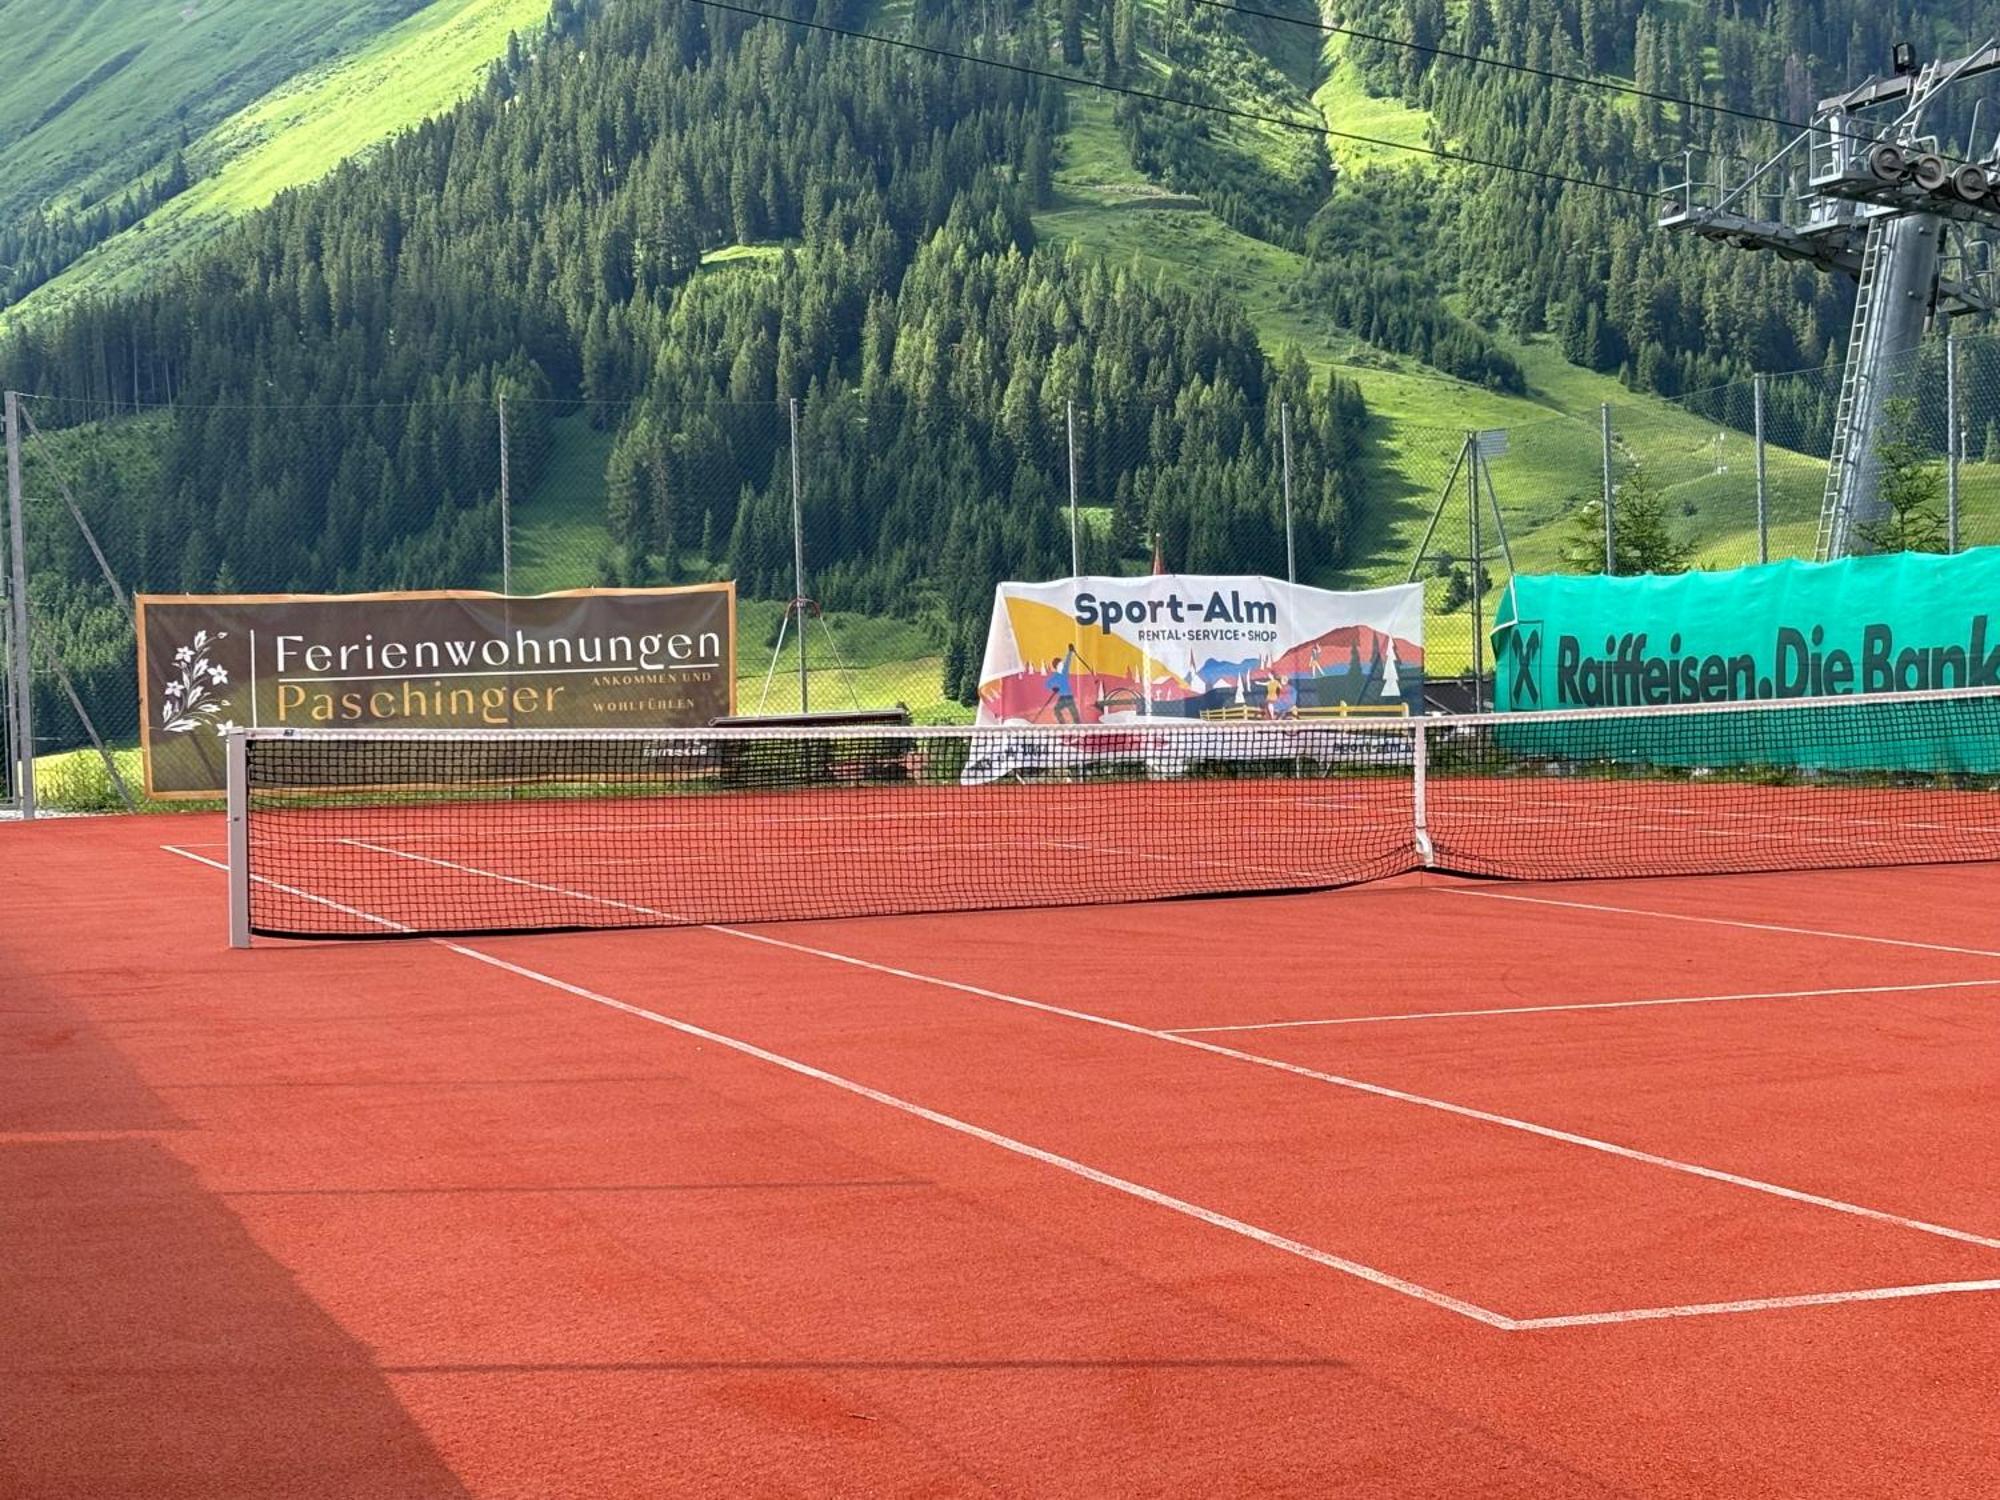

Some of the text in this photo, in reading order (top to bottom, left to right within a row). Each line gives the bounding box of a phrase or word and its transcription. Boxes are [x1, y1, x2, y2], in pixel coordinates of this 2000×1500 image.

[1075, 591, 1277, 634] Sport-Alm
[276, 630, 720, 672] Ferienwohnungen
[1138, 629, 1278, 642] RENTAL SERVICE SHOP
[1863, 615, 2000, 694] Bank
[592, 671, 712, 687] ANKOMMEN UND
[278, 681, 565, 724] Paschinger
[593, 697, 695, 713] WOHLFÜHLEN
